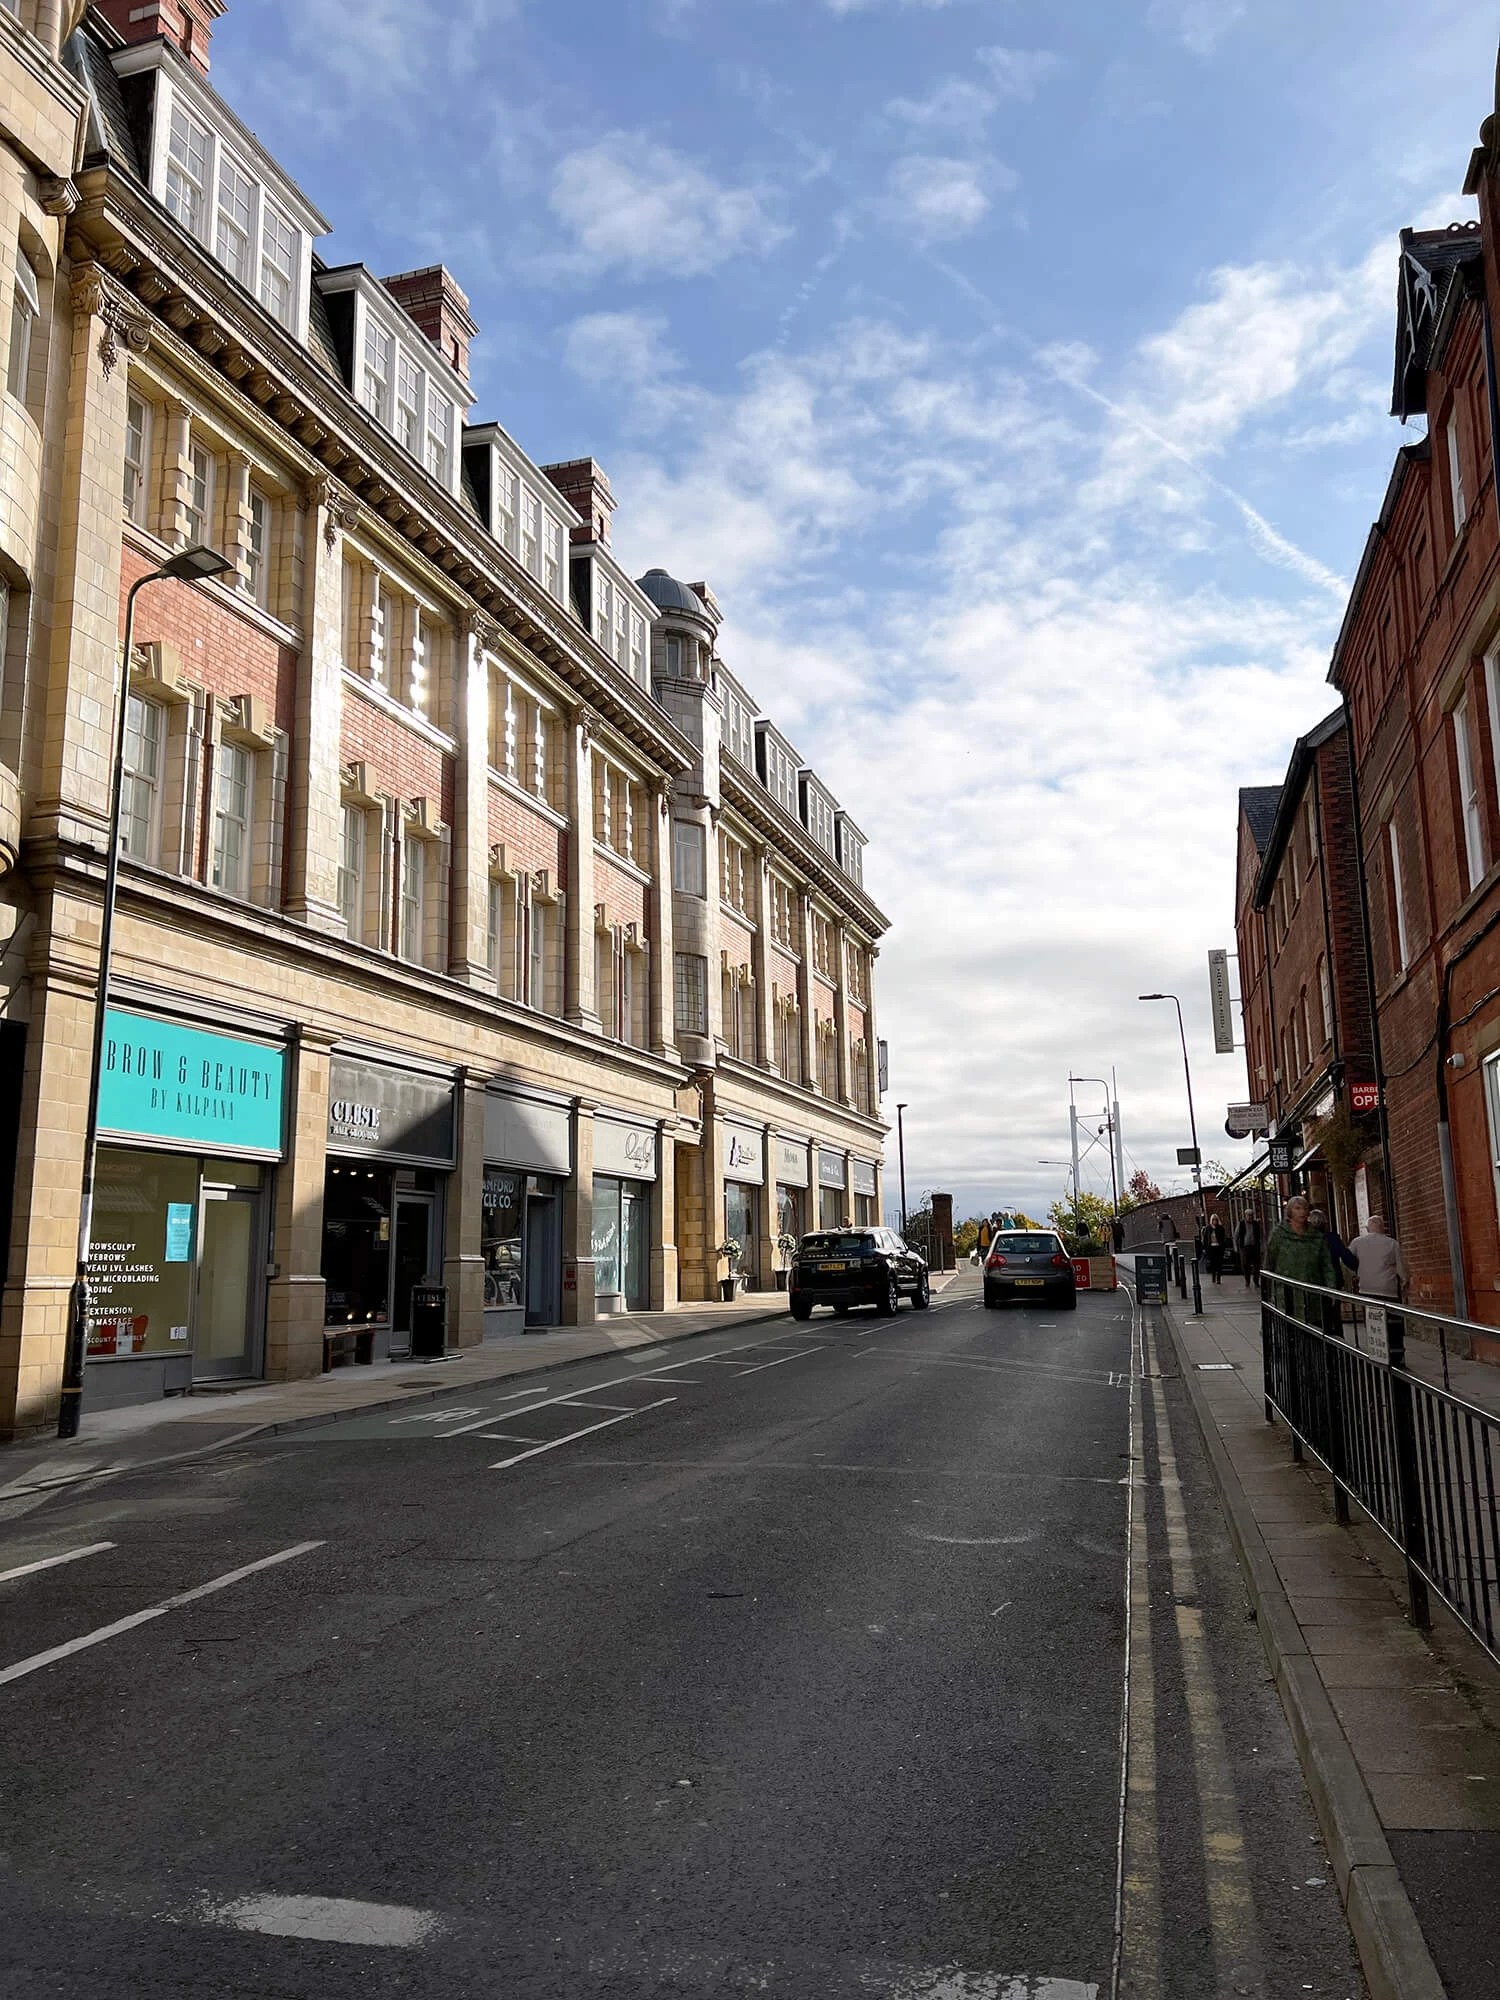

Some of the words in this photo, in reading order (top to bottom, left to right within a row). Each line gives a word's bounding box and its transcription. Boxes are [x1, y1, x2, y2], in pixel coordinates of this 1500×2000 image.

[106, 1040, 164, 1080] BROW
[178, 1056, 187, 1085] &
[201, 1060, 272, 1100] BEAUTY
[151, 1088, 168, 1110] BY
[176, 1092, 234, 1121] KALPANA
[331, 1101, 381, 1127] CLOSE
[89, 1242, 136, 1251] ROWSCULPT
[88, 1253, 126, 1261] YEBROWS
[109, 1264, 123, 1272] LVL
[125, 1264, 154, 1272] LASHES
[102, 1275, 160, 1283] MICROBLADING
[89, 1306, 133, 1315] EXTENSION
[95, 1317, 132, 1326] MASSAGE
